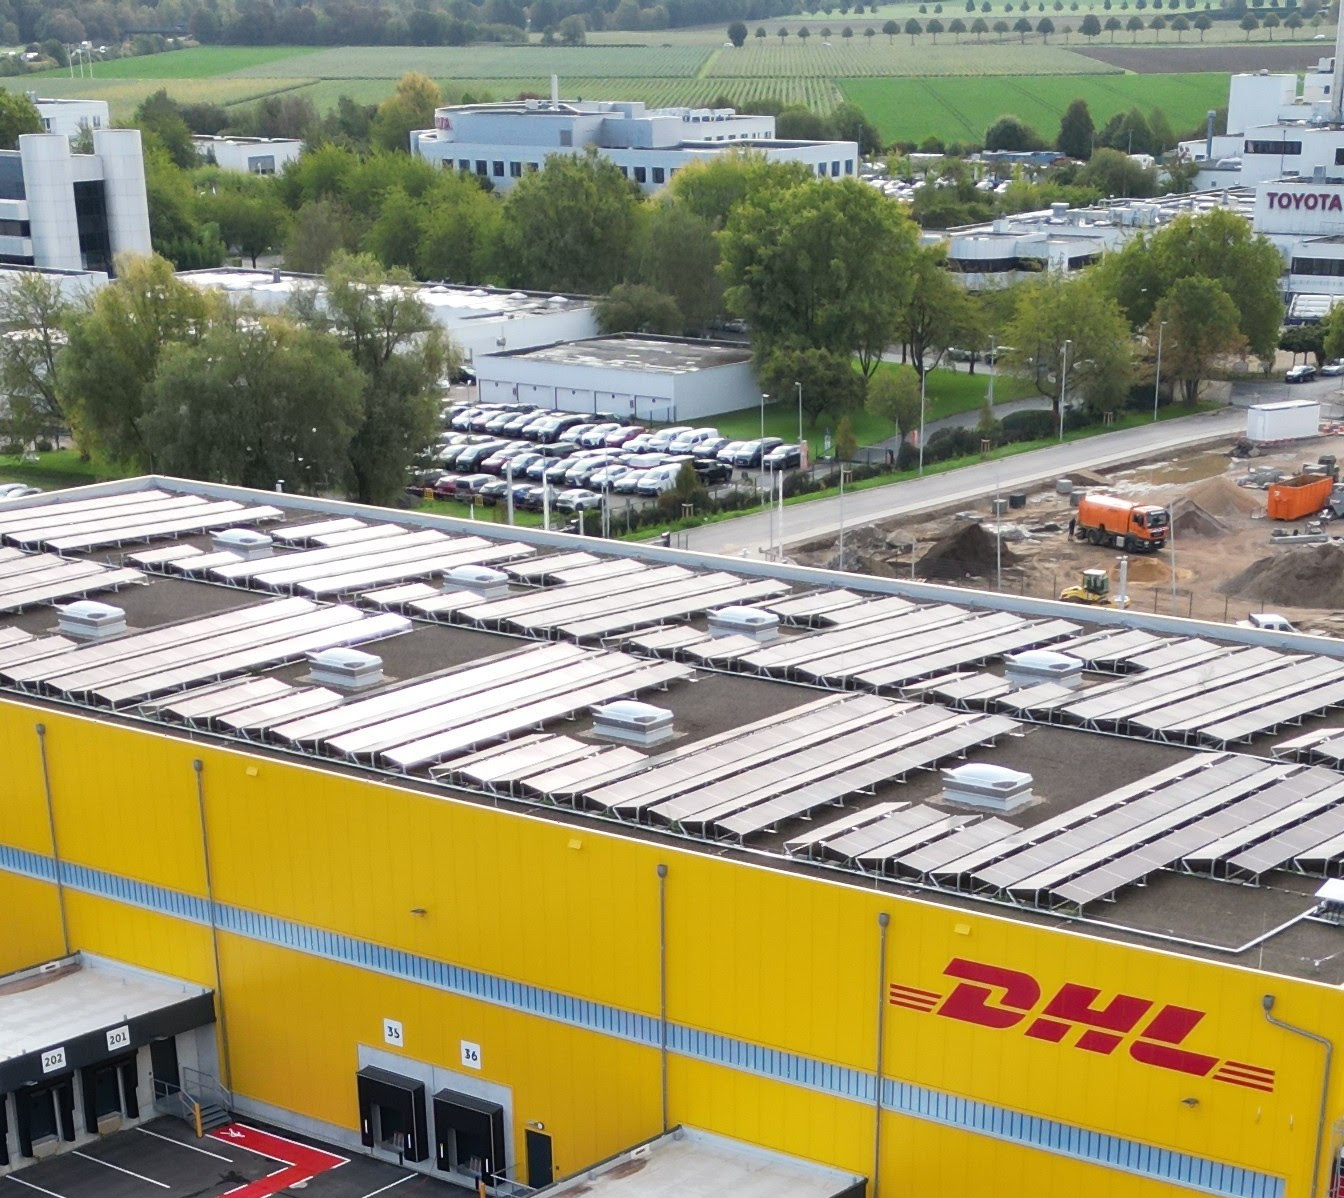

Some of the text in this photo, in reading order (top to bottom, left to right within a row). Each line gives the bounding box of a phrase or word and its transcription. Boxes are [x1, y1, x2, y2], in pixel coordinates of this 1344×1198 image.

[1267, 191, 1343, 212] TOYOTA
[937, 957, 1220, 1077] DHL
[109, 1032, 127, 1045] 201
[387, 1025, 400, 1039] 35
[44, 1053, 63, 1068] 202
[464, 1048, 478, 1062] 36
